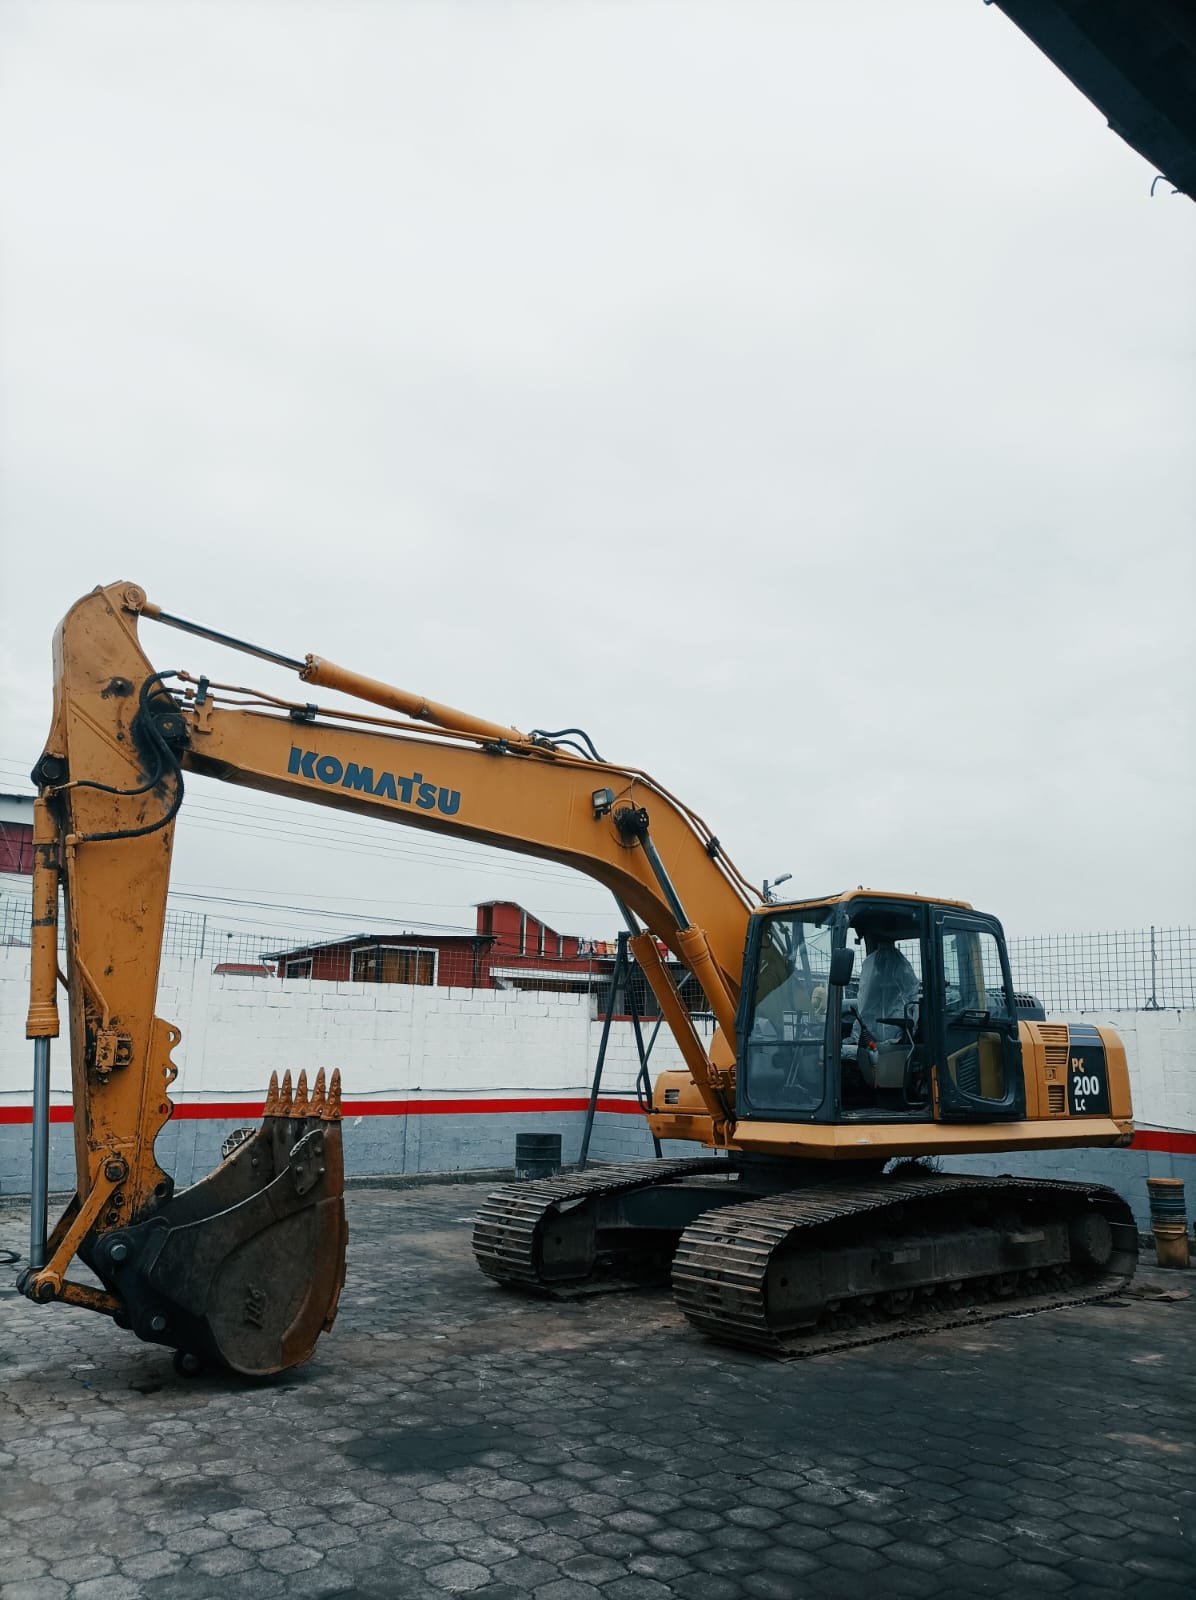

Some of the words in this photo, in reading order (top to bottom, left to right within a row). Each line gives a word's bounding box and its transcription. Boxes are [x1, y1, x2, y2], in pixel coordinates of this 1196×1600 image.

[287, 747, 461, 815] KOMATSU
[1071, 1057, 1085, 1073] PC
[1073, 1075, 1099, 1095] 200
[1074, 1098, 1086, 1111] LC
